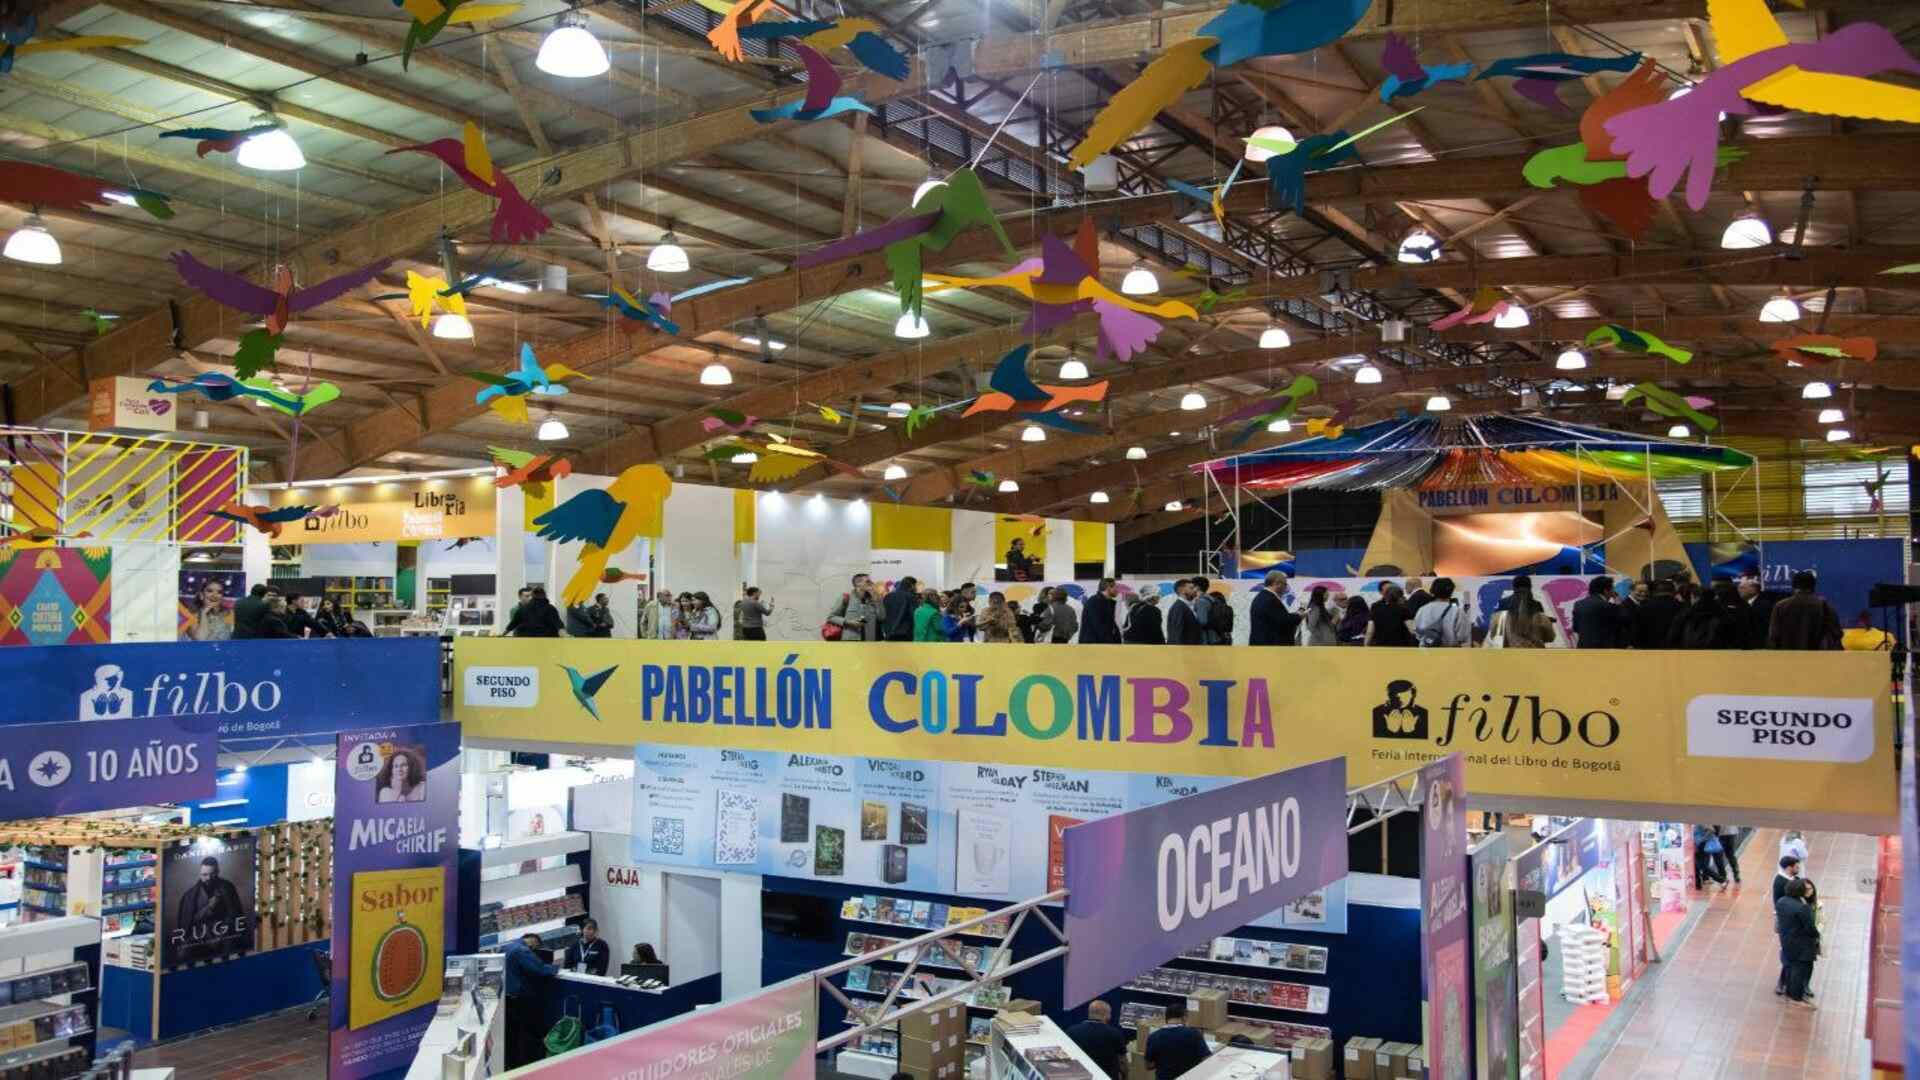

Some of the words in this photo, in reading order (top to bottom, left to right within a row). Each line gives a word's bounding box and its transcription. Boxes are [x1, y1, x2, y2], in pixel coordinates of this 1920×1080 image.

[1418, 487, 1488, 507] PABELLÓN
[1498, 483, 1618, 505] COLOMBIA
[144, 671, 281, 717] filbo
[476, 675, 531, 687] SEGUNDO
[490, 687, 517, 698] PISO
[642, 654, 832, 729] PABELLÓN
[868, 669, 1276, 749] COLOMBIA
[1435, 693, 1621, 748] filbo
[1717, 709, 1853, 729] SEGUNDO
[1752, 729, 1816, 746] PISO
[87, 749, 118, 782] 10
[127, 740, 200, 779] AÑOS
[1371, 749, 1401, 761] Feria
[1490, 756, 1511, 766] del
[1514, 757, 1548, 769] Libro
[1552, 757, 1568, 769] de
[1573, 758, 1621, 773] Bogotá
[349, 815, 426, 851] MICAELA
[396, 827, 448, 854] CHIRIF
[607, 867, 640, 886] CAJA
[1157, 797, 1301, 933] OCEANO
[360, 883, 440, 913] Sabor
[171, 916, 248, 945] RUGE
[722, 1011, 802, 1052] OFICIALES
